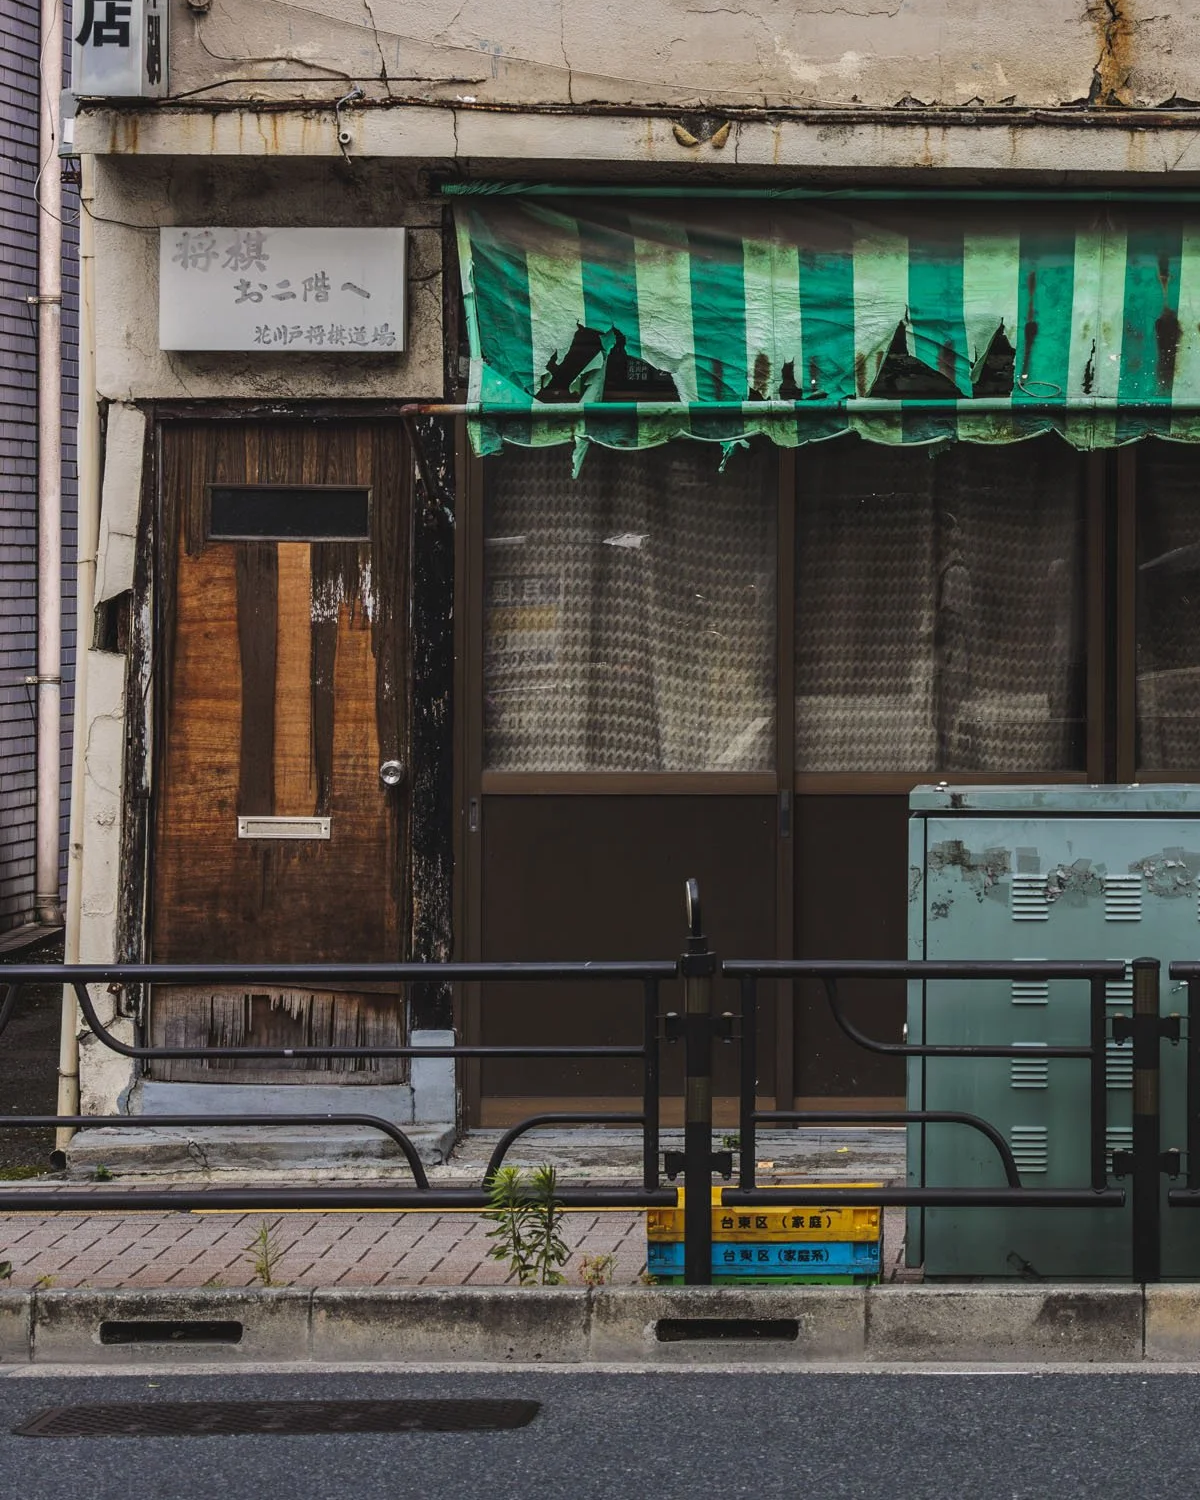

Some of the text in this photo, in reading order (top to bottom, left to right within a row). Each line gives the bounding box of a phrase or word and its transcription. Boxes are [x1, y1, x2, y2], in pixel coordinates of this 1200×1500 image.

[171, 229, 270, 273] 将棋
[233, 271, 371, 304] お二階へ
[253, 322, 397, 346] 花川戸将棋道場
